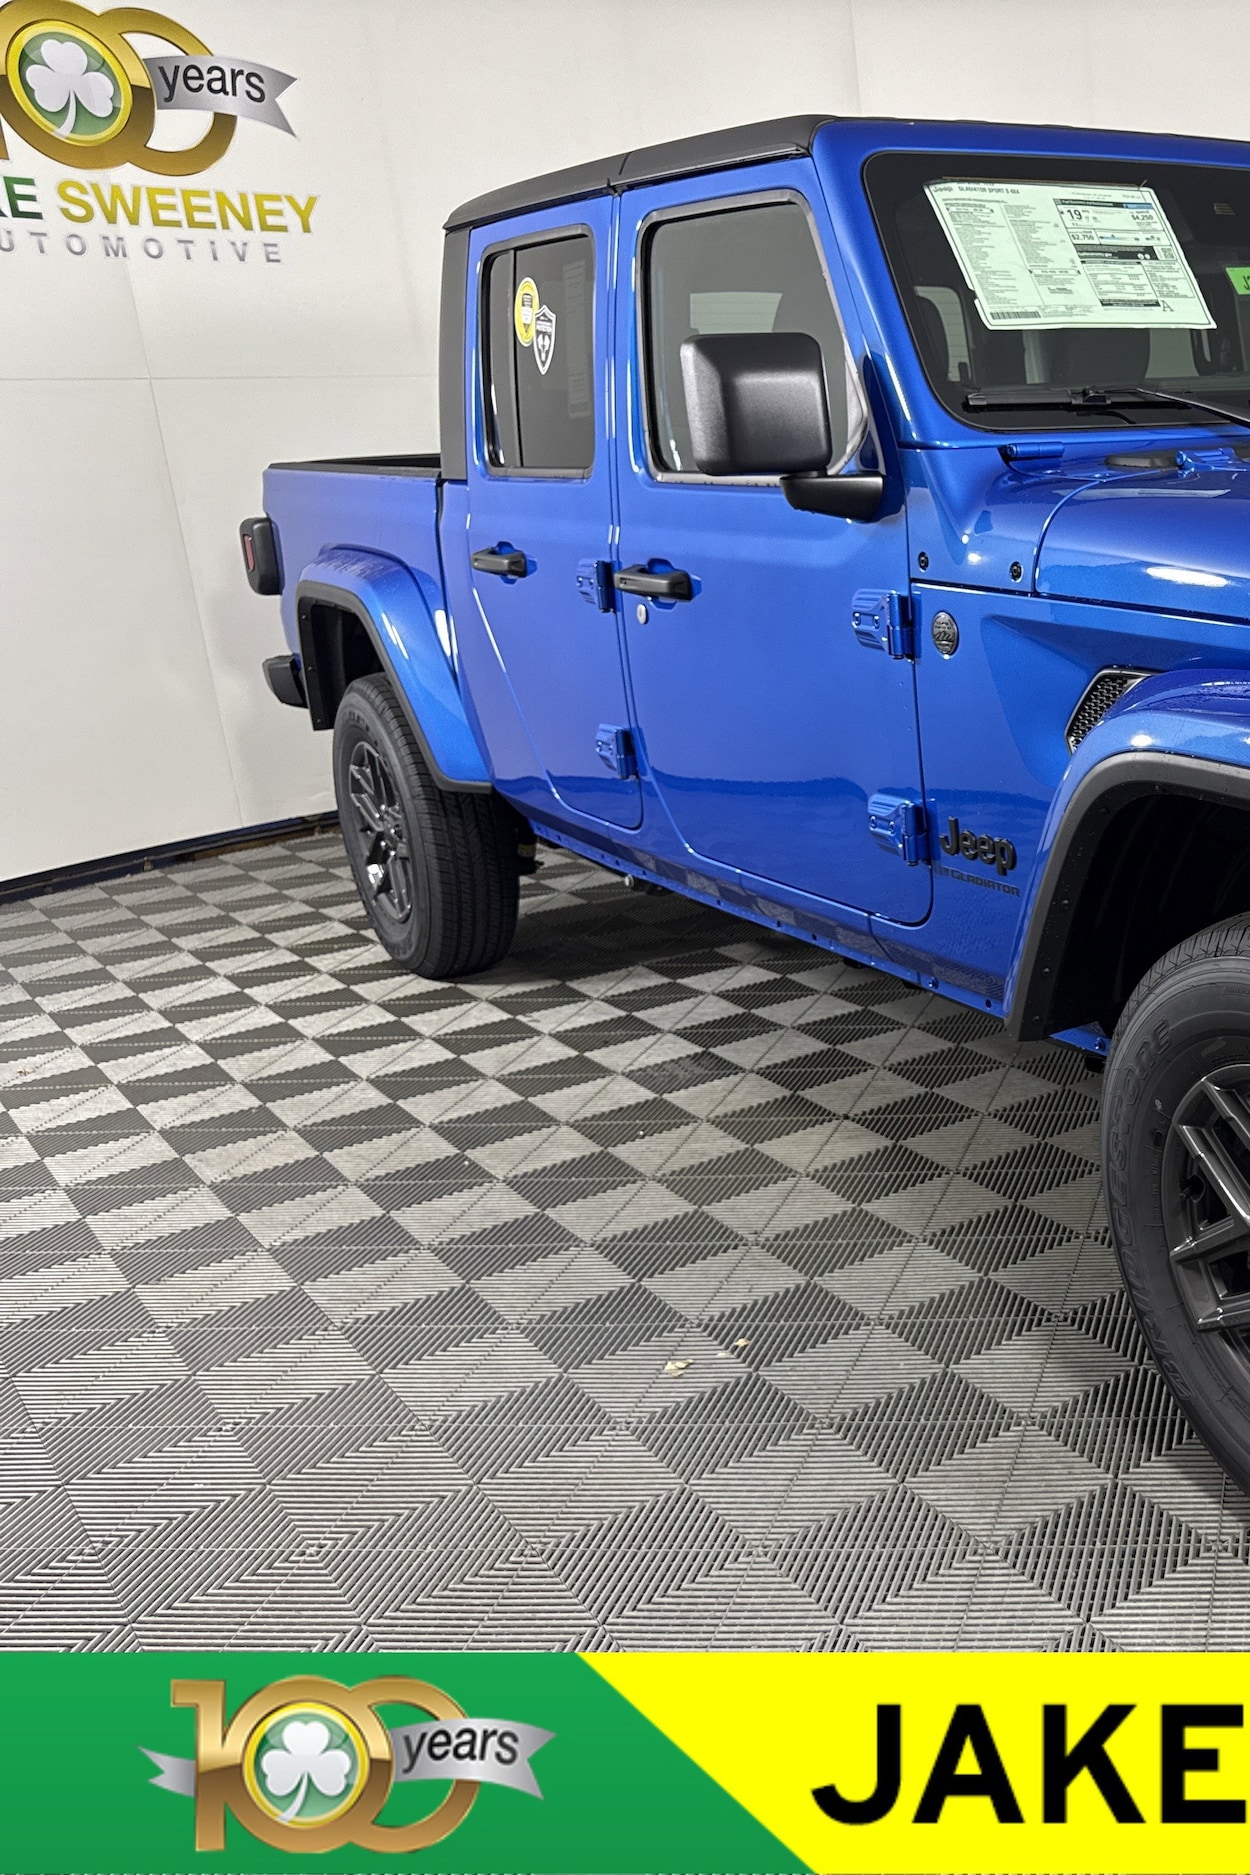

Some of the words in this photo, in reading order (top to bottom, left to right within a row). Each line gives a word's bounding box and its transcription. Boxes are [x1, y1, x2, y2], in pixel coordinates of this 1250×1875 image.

[157, 62, 266, 103] years
[57, 180, 318, 233] SWEENEY
[1066, 209, 1083, 220] 19
[0, 230, 281, 263] UTOMOTIVE
[939, 815, 1017, 876] Jeep
